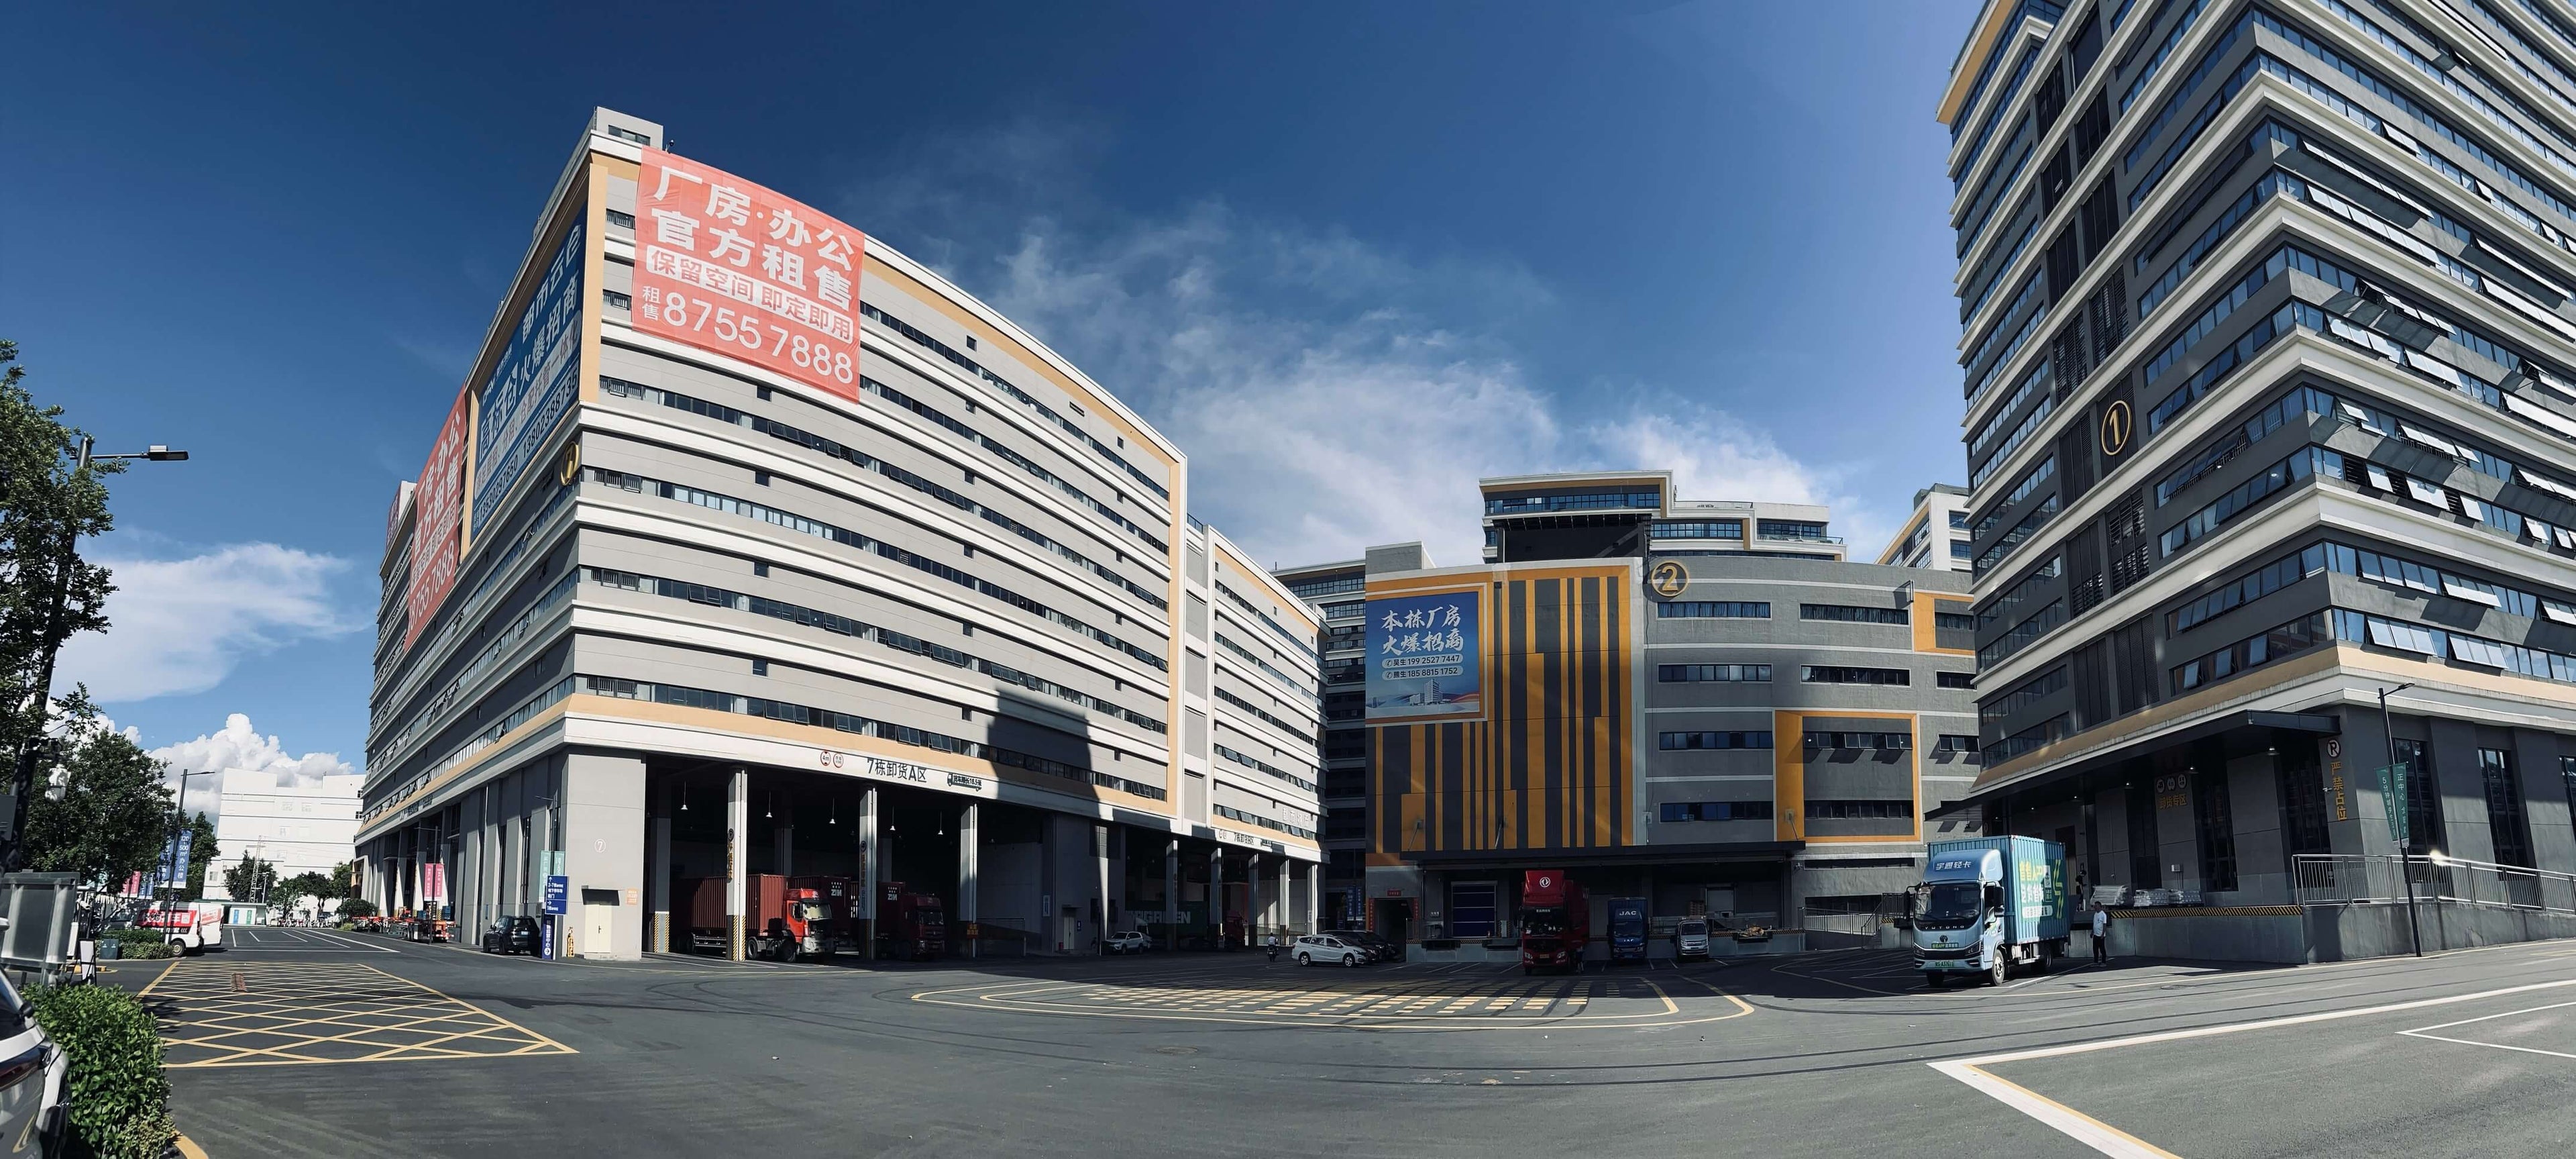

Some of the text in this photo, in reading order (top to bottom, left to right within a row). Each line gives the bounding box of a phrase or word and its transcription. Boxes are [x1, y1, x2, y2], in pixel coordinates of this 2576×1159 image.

[651, 208, 852, 311] 官方租售
[641, 287, 660, 321] 租售
[651, 249, 851, 339] 保留空间 即定即用
[663, 292, 853, 385] 8755 7888
[523, 372, 578, 459] 13802388735
[431, 538, 455, 598] 7888
[1381, 605, 1461, 632] 本栋厂房
[1381, 627, 1464, 656] 火爆招商
[1421, 656, 1440, 664] 2527
[867, 758, 927, 783] 7栋卸货A区
[2330, 762, 2347, 821] 严禁占位
